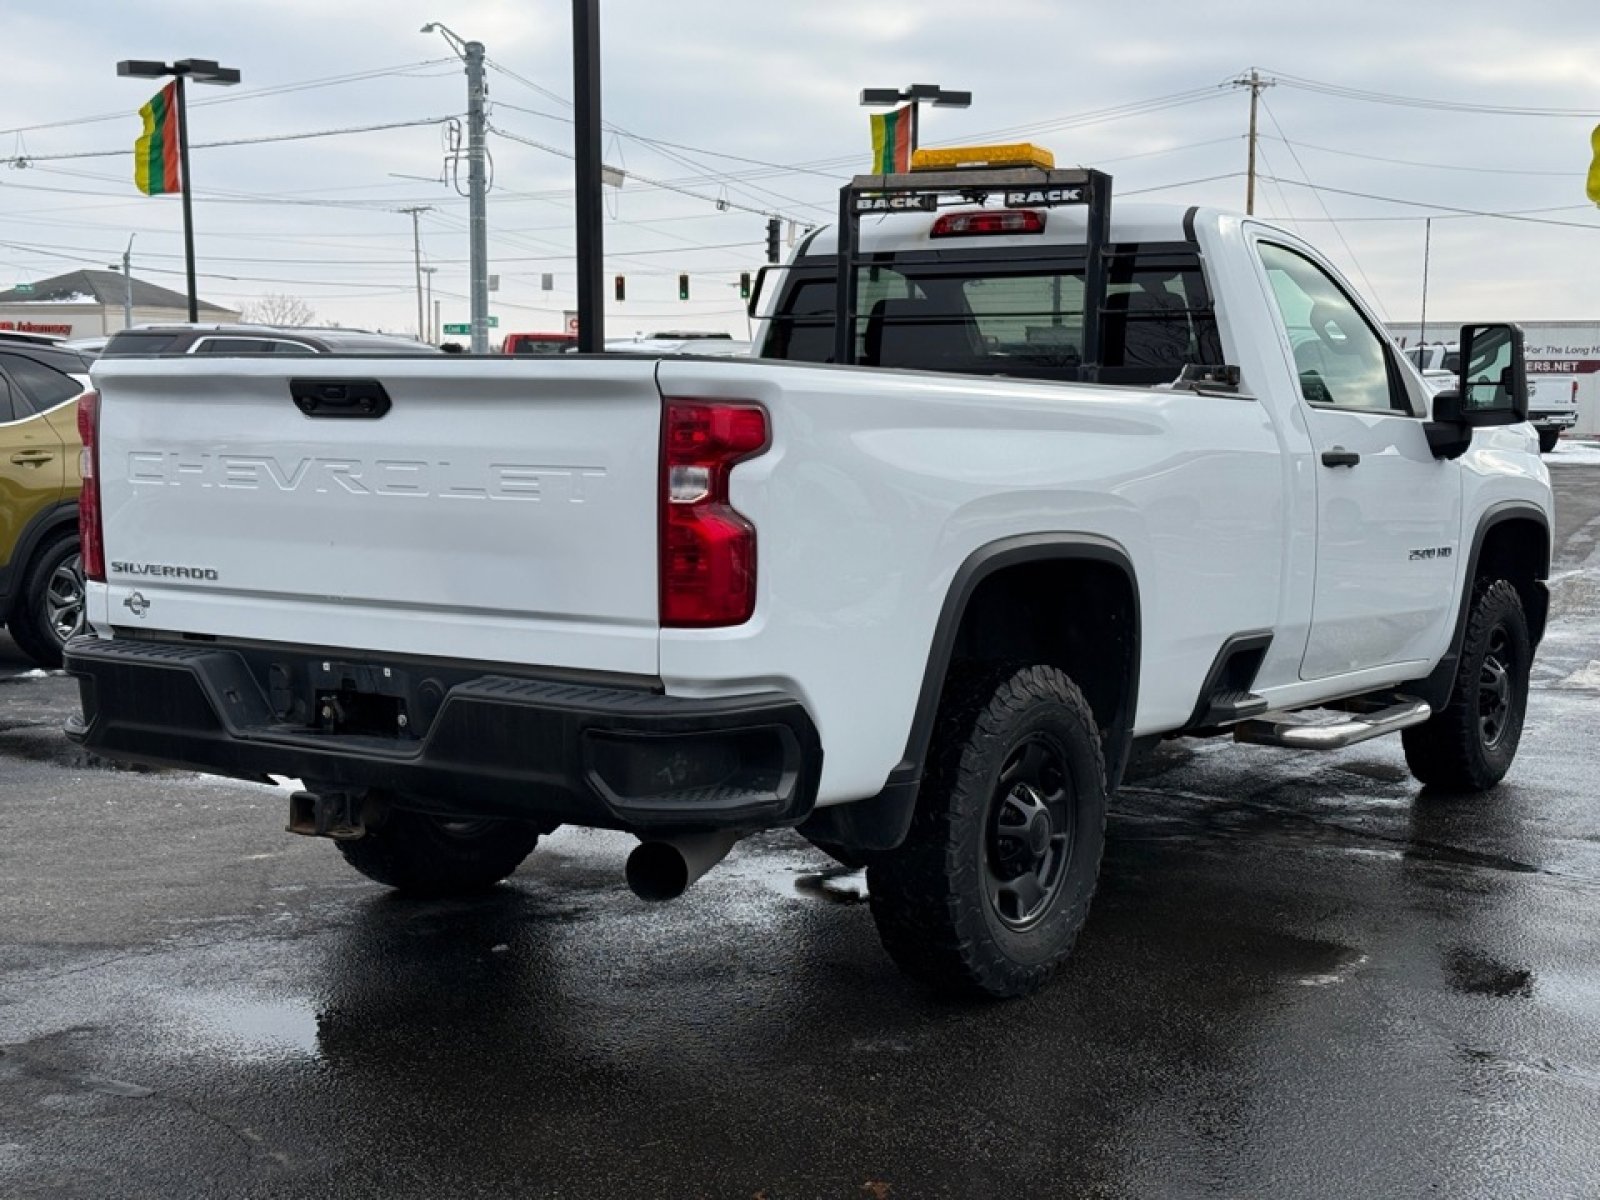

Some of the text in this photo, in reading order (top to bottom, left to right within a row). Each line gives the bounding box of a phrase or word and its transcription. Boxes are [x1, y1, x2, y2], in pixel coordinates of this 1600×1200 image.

[856, 189, 1082, 209] BACK RACK
[1546, 345, 1563, 354] The
[1565, 345, 1590, 356] Long
[127, 450, 608, 503] CHEVROLET
[1437, 547, 1452, 557] HD
[111, 561, 219, 581] SILVERADO
